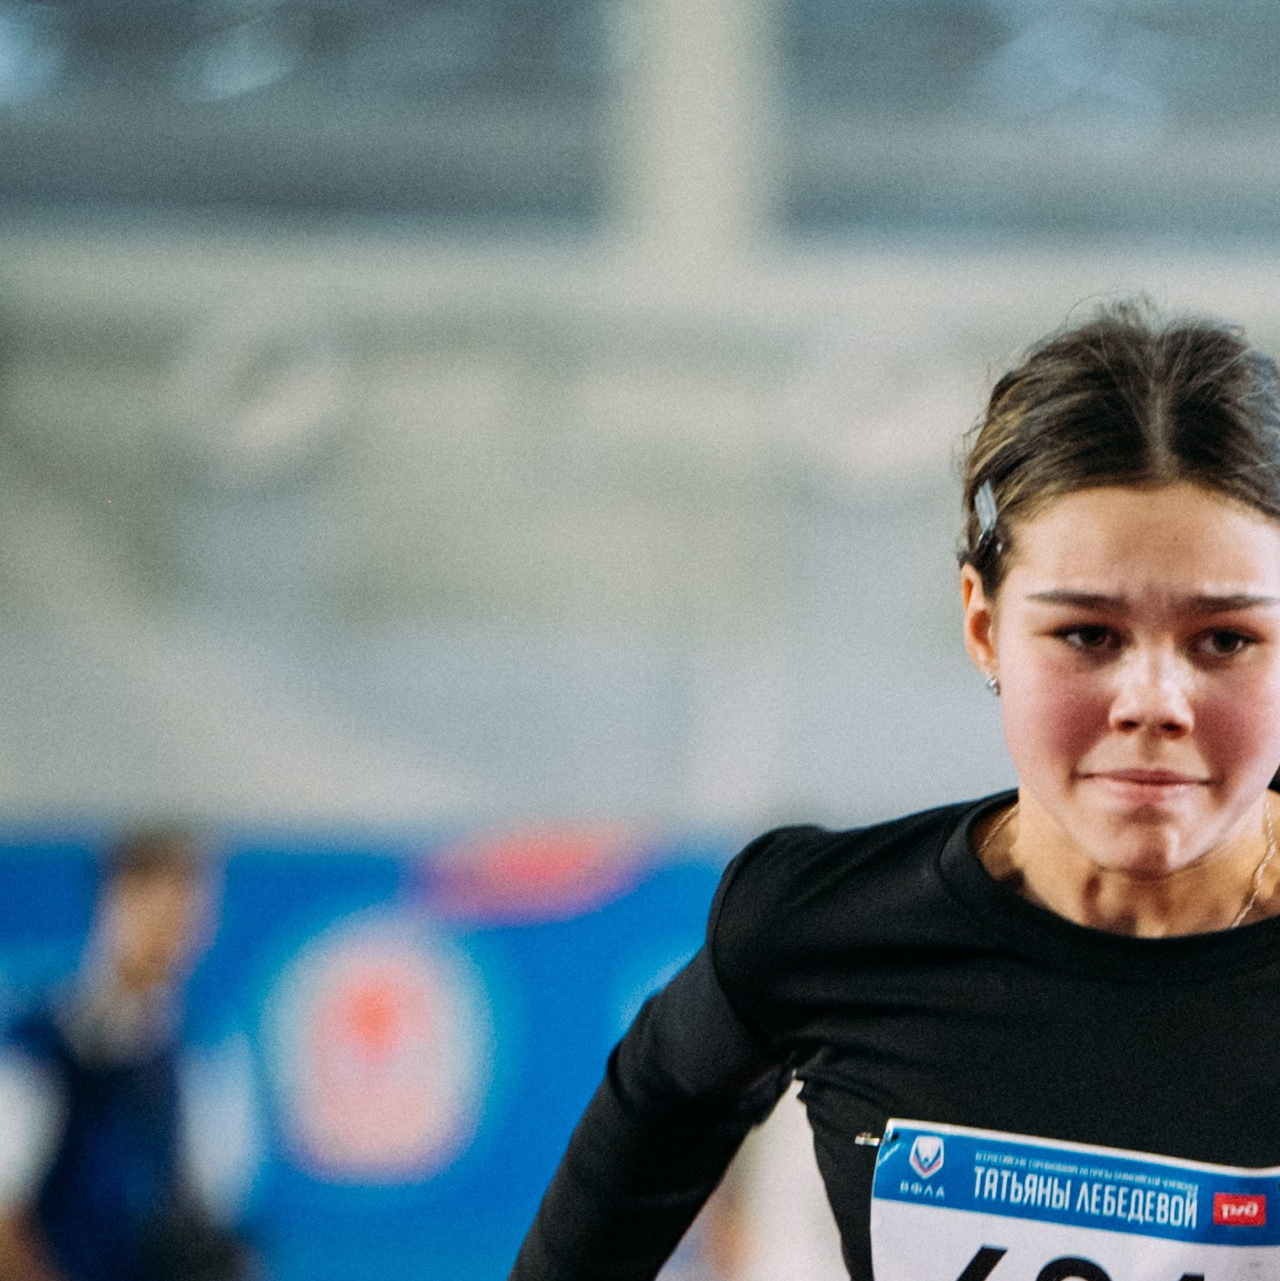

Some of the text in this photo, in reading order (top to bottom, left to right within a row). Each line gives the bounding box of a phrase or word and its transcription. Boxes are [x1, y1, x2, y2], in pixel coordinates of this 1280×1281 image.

[900, 1180, 945, 1199] ВФЛА
[974, 1165, 1072, 1211] ТАТЬЯНЫ
[1076, 1181, 1199, 1230] ЛЕБЕДЕВОЙ
